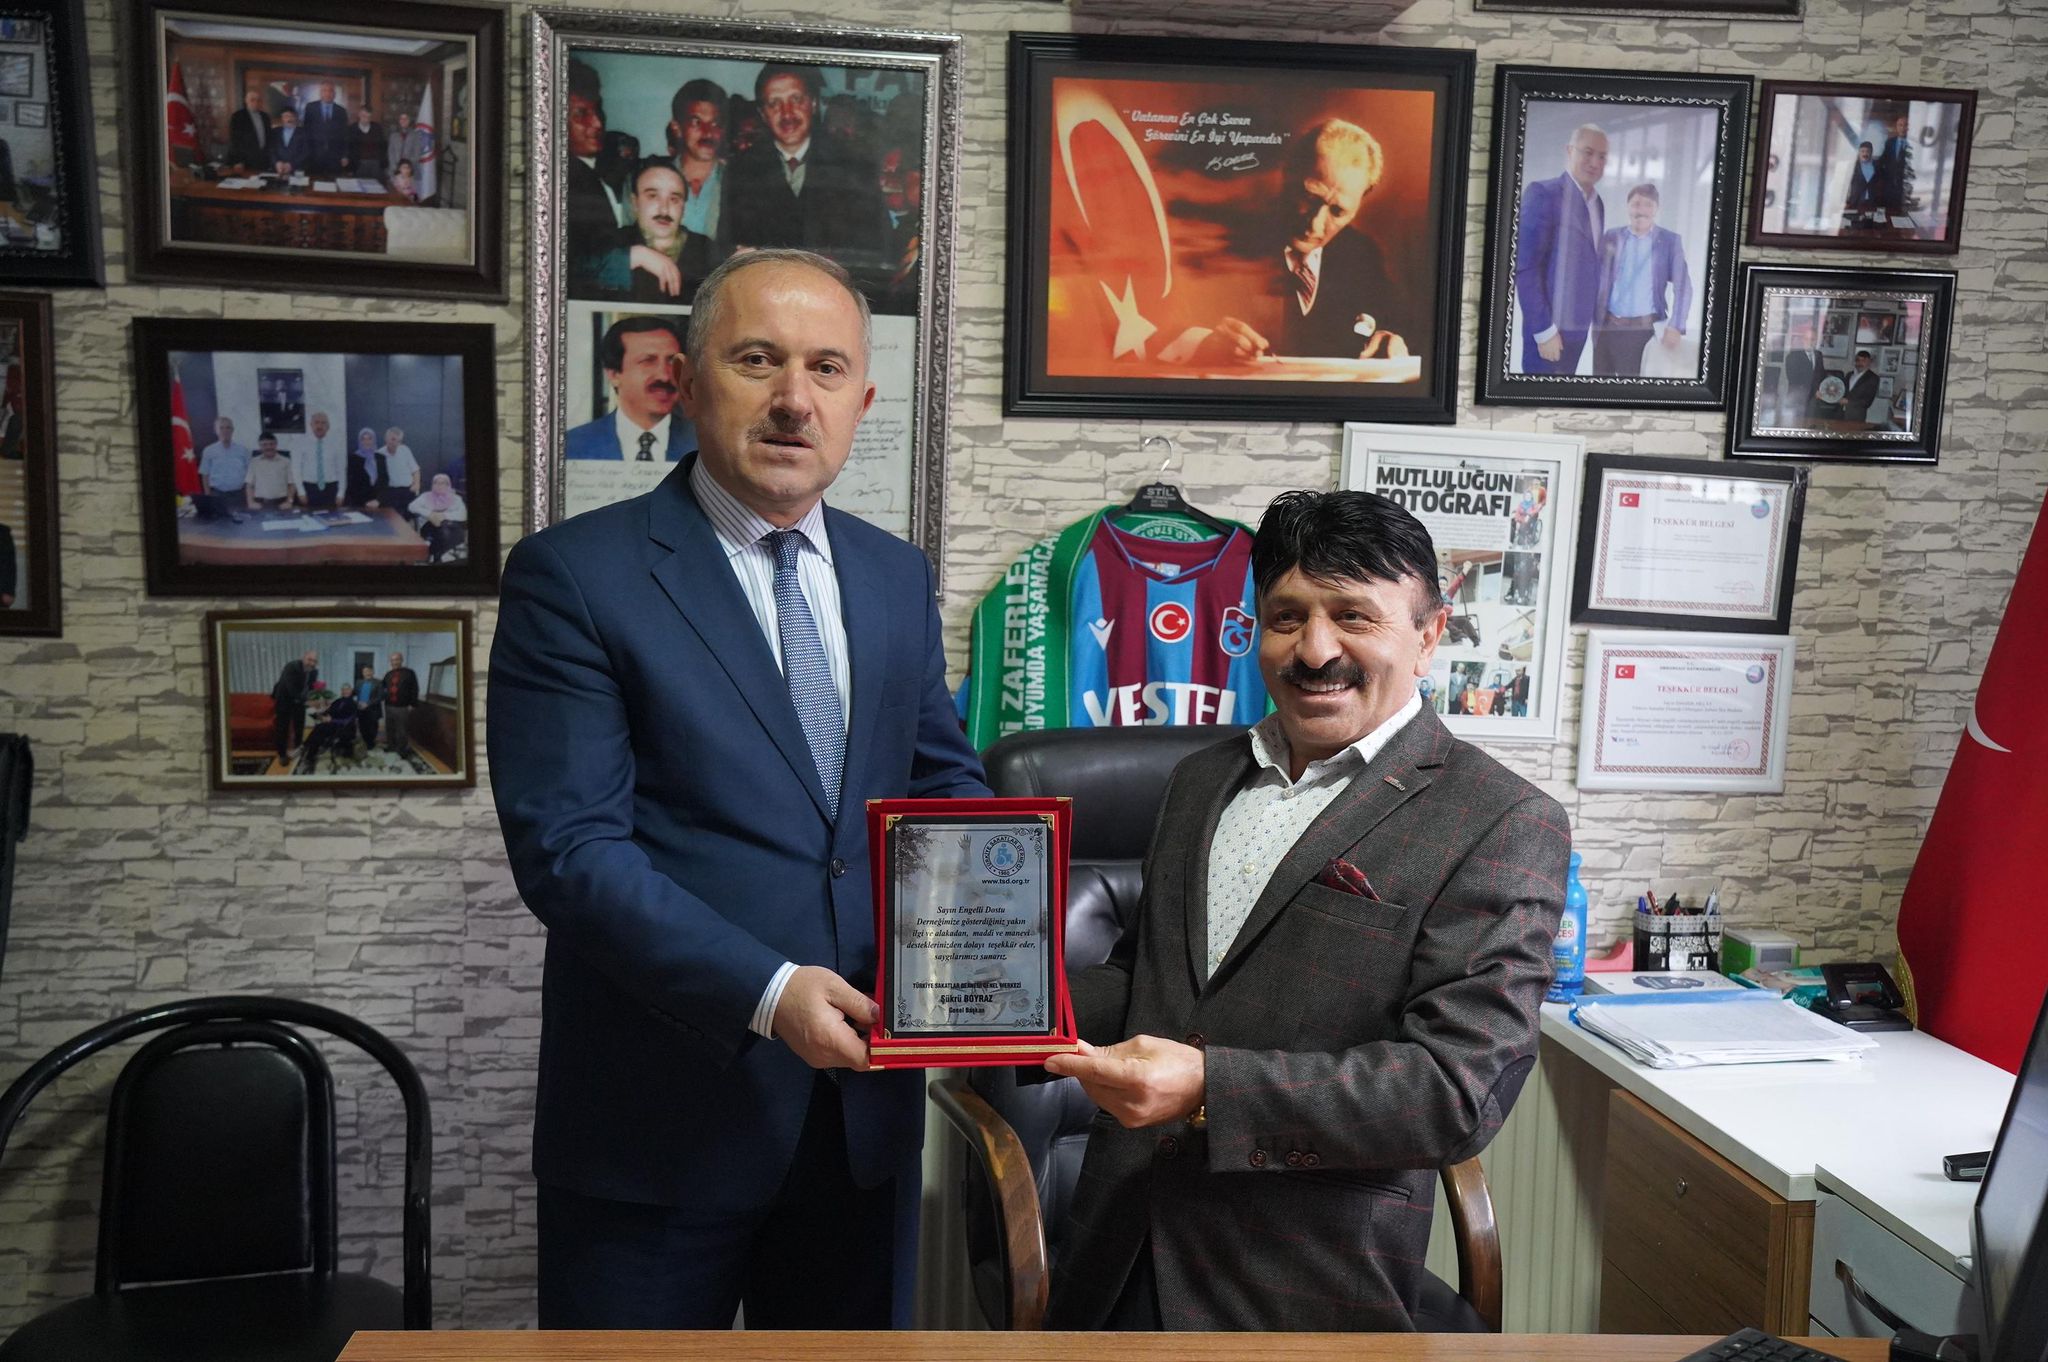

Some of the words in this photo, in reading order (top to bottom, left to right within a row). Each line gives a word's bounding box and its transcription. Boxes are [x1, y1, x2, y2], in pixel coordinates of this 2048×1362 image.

[1179, 112, 1195, 126] En
[1189, 130, 1205, 144] En
[1375, 466, 1513, 493] MUTLULUĞUN
[1027, 529, 1063, 642] YAŞANACA
[1024, 645, 1046, 731] DYUMDA
[981, 878, 1031, 886] www.tsd.org.tr
[936, 905, 957, 916] Sayın
[958, 905, 984, 916] Engelli
[984, 905, 1006, 914] Dostu
[916, 917, 960, 927] Derneğimize
[961, 917, 1005, 928] gösterdiğiniz
[1006, 917, 1026, 927] yakın
[934, 929, 969, 938] alakadan,
[972, 929, 994, 937] maddi
[906, 940, 962, 949] desteklerinizden
[963, 940, 985, 950] dolayı
[988, 940, 1018, 950] teşekkür
[1018, 940, 1036, 949] eder,
[934, 953, 979, 962] saygılarımızı
[940, 994, 962, 1005] Şükrü
[963, 994, 994, 1003] BOYRAZ
[948, 1006, 965, 1014] Genel
